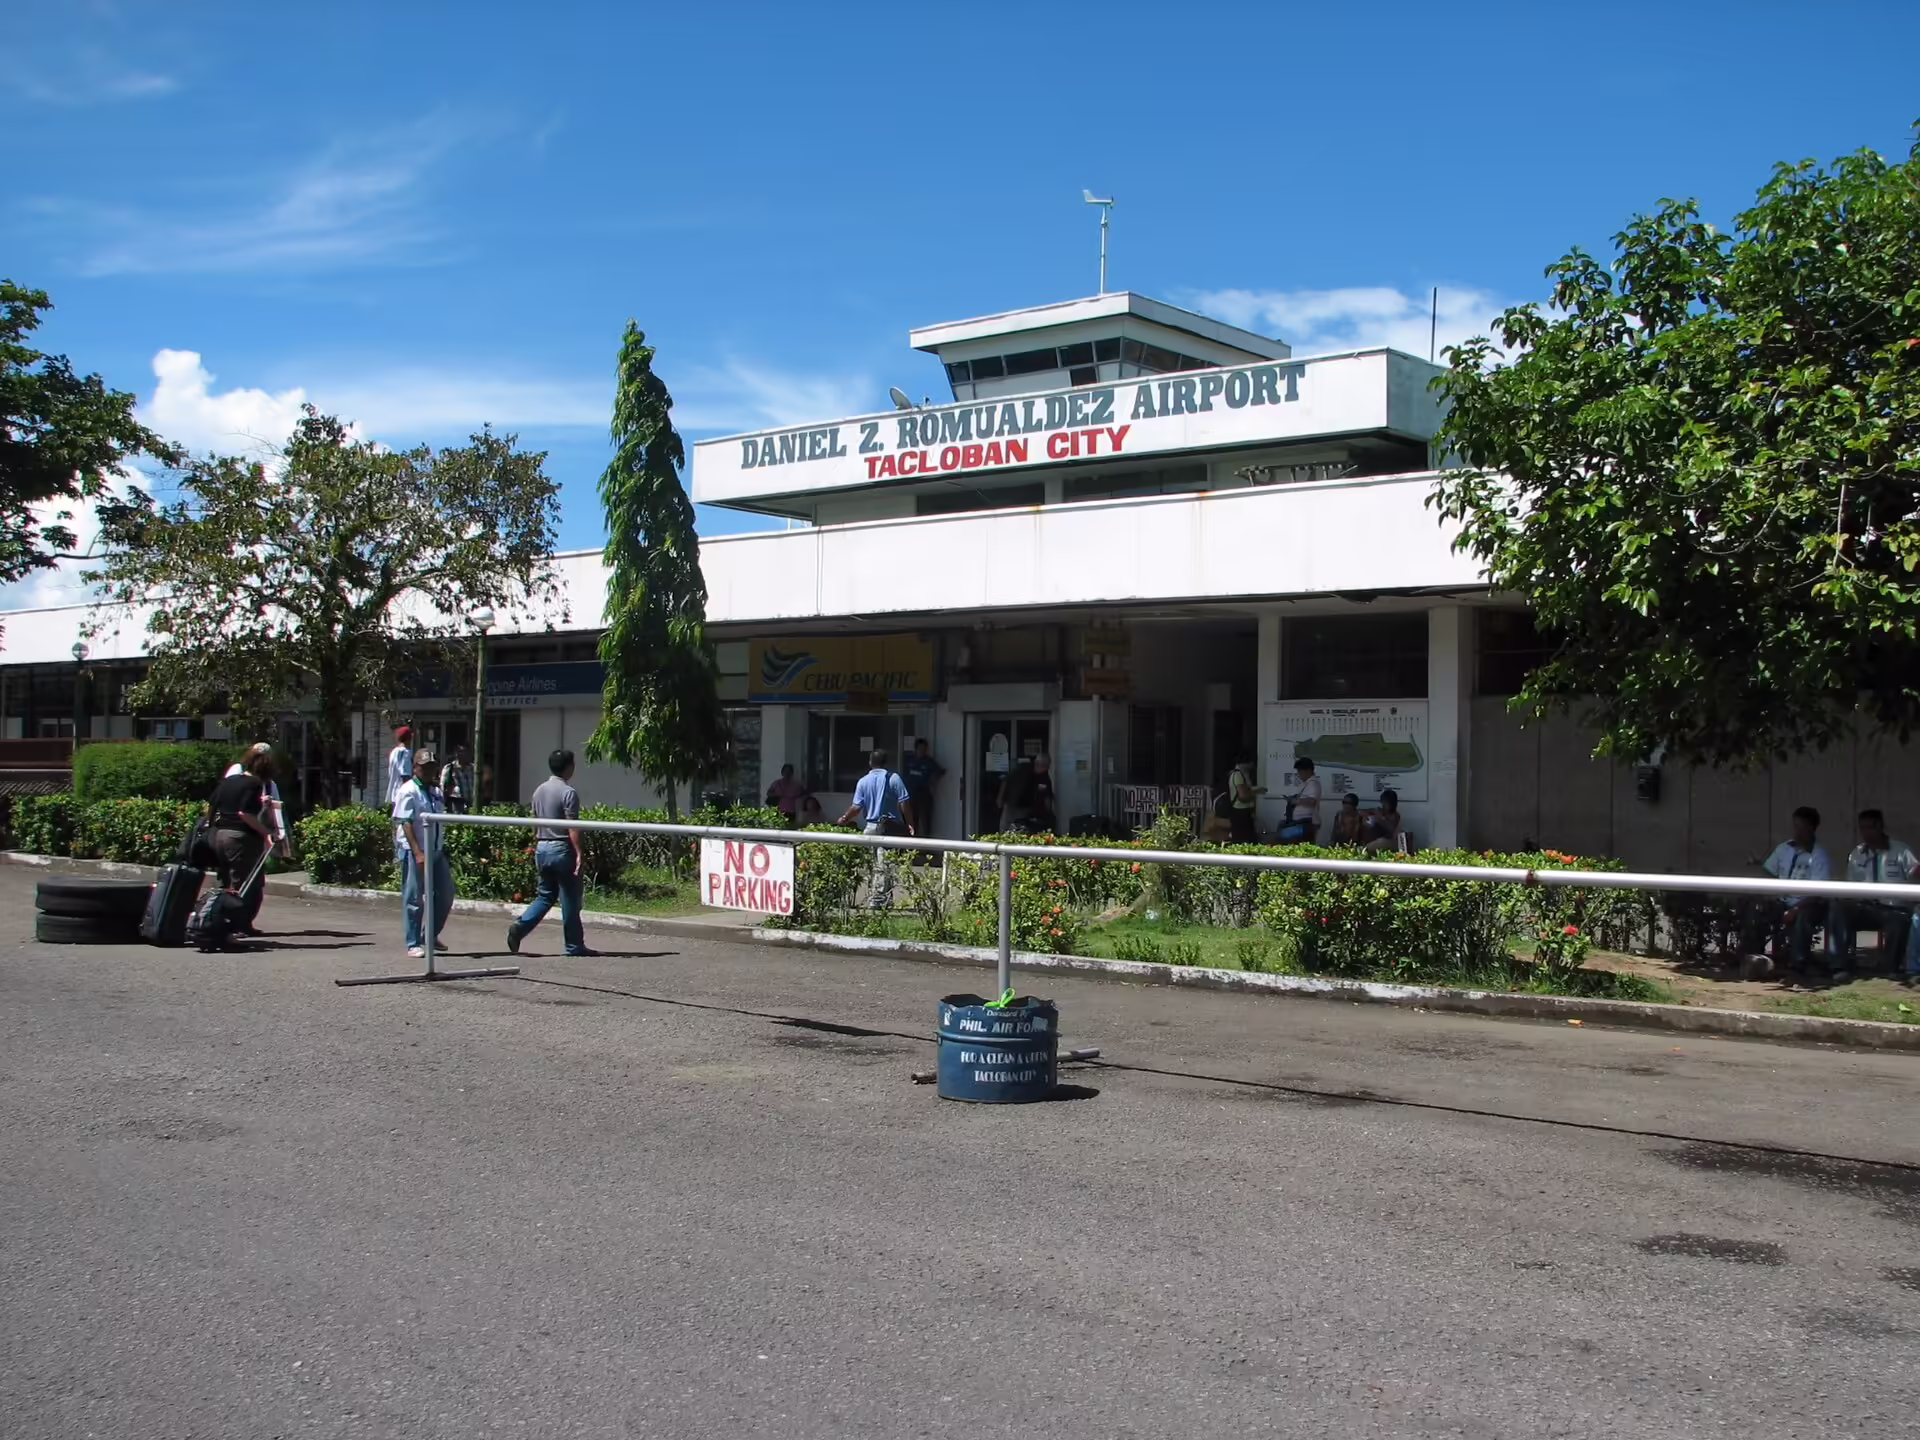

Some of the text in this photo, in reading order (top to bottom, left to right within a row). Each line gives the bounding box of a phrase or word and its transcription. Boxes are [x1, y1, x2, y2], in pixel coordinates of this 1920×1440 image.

[741, 364, 1305, 469] DANIEL Z. ROMUALDEZ AIRPORT
[864, 424, 1131, 480] TACLOBAN CITY
[517, 674, 557, 692] Airlines
[803, 672, 847, 691] CEBU
[723, 840, 770, 877] NO
[708, 872, 791, 914] PARKING
[959, 1019, 987, 1032] PHIL.
[991, 1021, 1013, 1034] AIR
[960, 1051, 977, 1064] FOR
[986, 1051, 1015, 1065] CLEAN
[974, 1070, 1018, 1083] TACLOBAN
